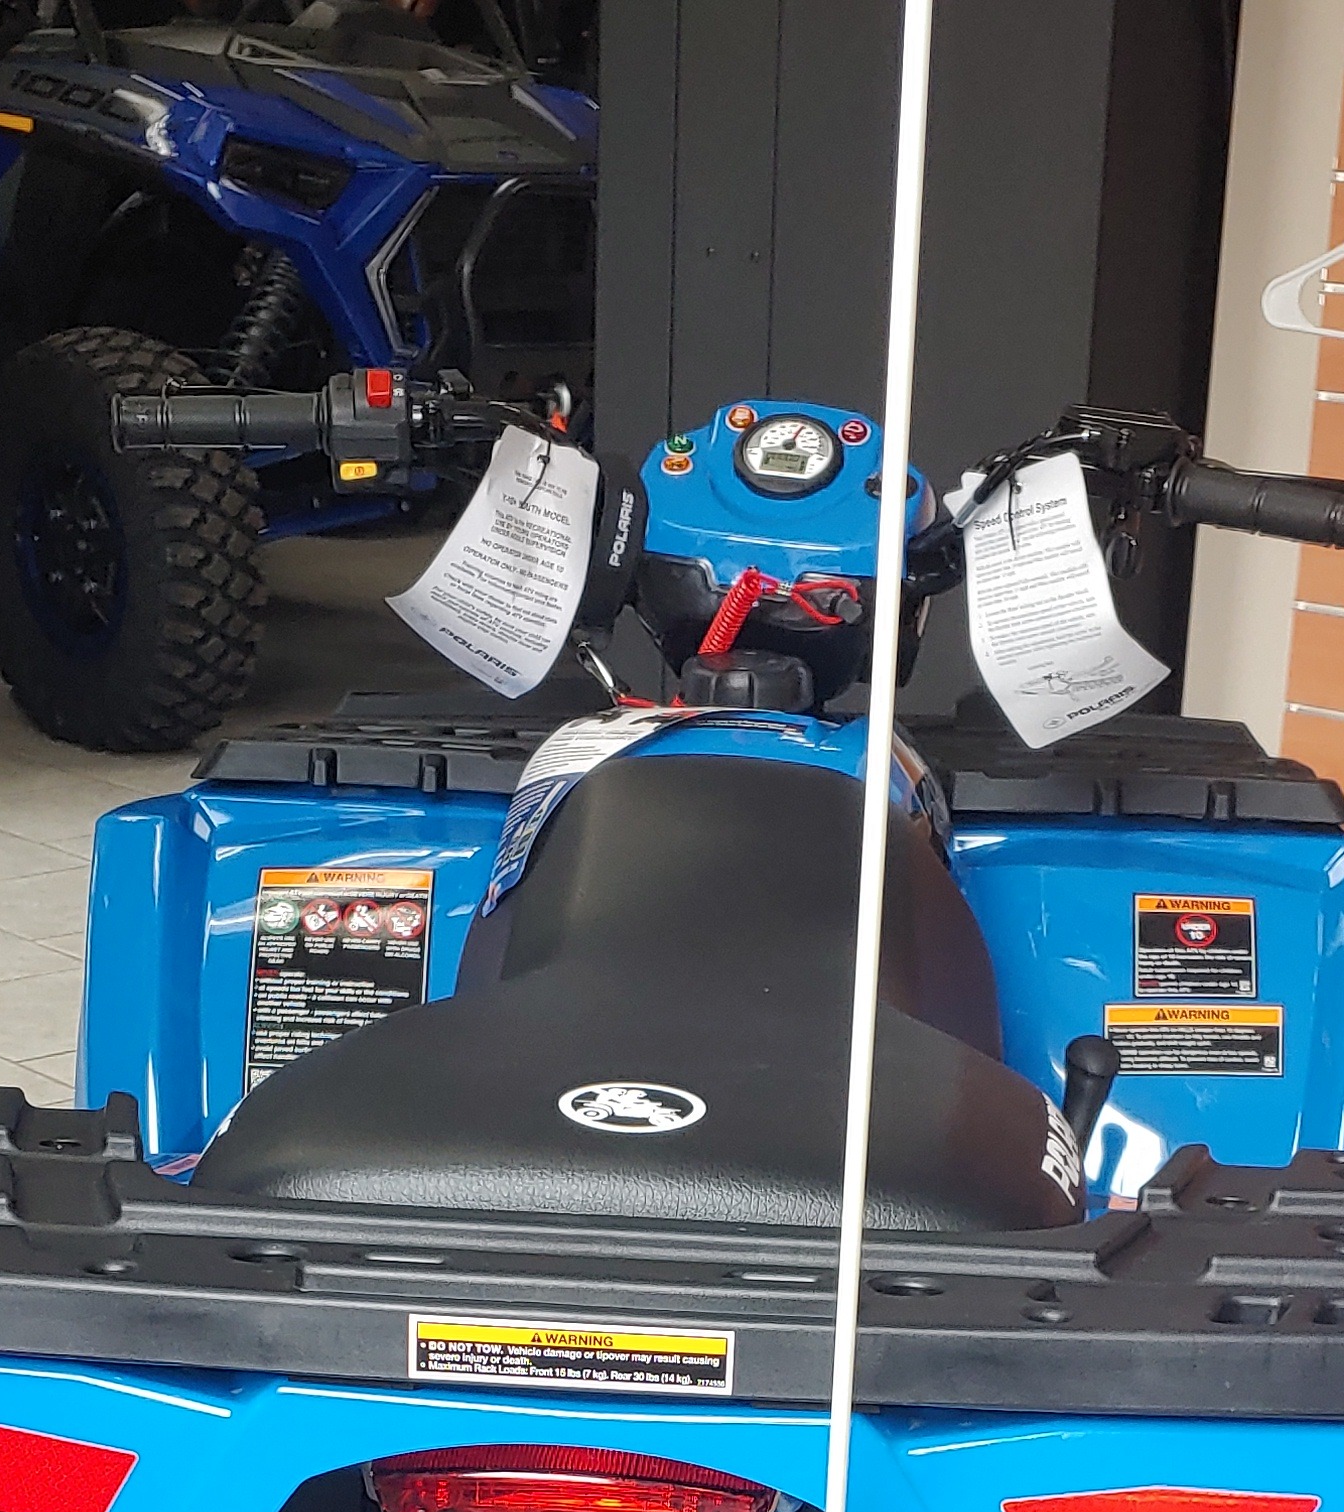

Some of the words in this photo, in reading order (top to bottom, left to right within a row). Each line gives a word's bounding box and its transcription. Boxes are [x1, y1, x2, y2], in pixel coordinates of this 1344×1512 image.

[674, 435, 687, 445] N
[542, 508, 571, 526] MODEL
[974, 513, 1002, 531] Speed
[1035, 498, 1068, 514] System
[608, 488, 634, 567] POLARIS
[438, 626, 521, 677] POLARIS
[1066, 685, 1136, 720] POLARIS
[322, 872, 386, 883] WARNING
[1169, 899, 1231, 911] WARNING
[1189, 931, 1205, 940] 10
[1167, 1009, 1230, 1021] WARNING
[1041, 1092, 1080, 1207] POLAR
[545, 1333, 613, 1347] WARNING
[428, 1341, 446, 1351] DO
[448, 1342, 474, 1353] NOT
[475, 1343, 504, 1355] TOW.
[507, 1346, 542, 1357] Vehicle
[543, 1347, 582, 1360] damage
[583, 1352, 595, 1360] or
[596, 1351, 630, 1362] tipover
[631, 1354, 653, 1364] may
[653, 1354, 680, 1364] result
[682, 1356, 720, 1367] causing
[428, 1352, 461, 1361] severe
[462, 1353, 488, 1365] injury
[490, 1356, 502, 1364] or
[502, 1356, 533, 1366] death.
[428, 1361, 472, 1372] Maximum
[474, 1363, 497, 1374] Rack
[498, 1364, 528, 1375] Loads:
[529, 1366, 554, 1377] Front
[567, 1368, 581, 1378] lbs
[582, 1369, 592, 1380] (7
[610, 1370, 632, 1381] Rear
[632, 1371, 645, 1382] 30
[645, 1371, 660, 1383] lbs
[661, 1372, 675, 1384] (14
[676, 1373, 693, 1386] kg).
